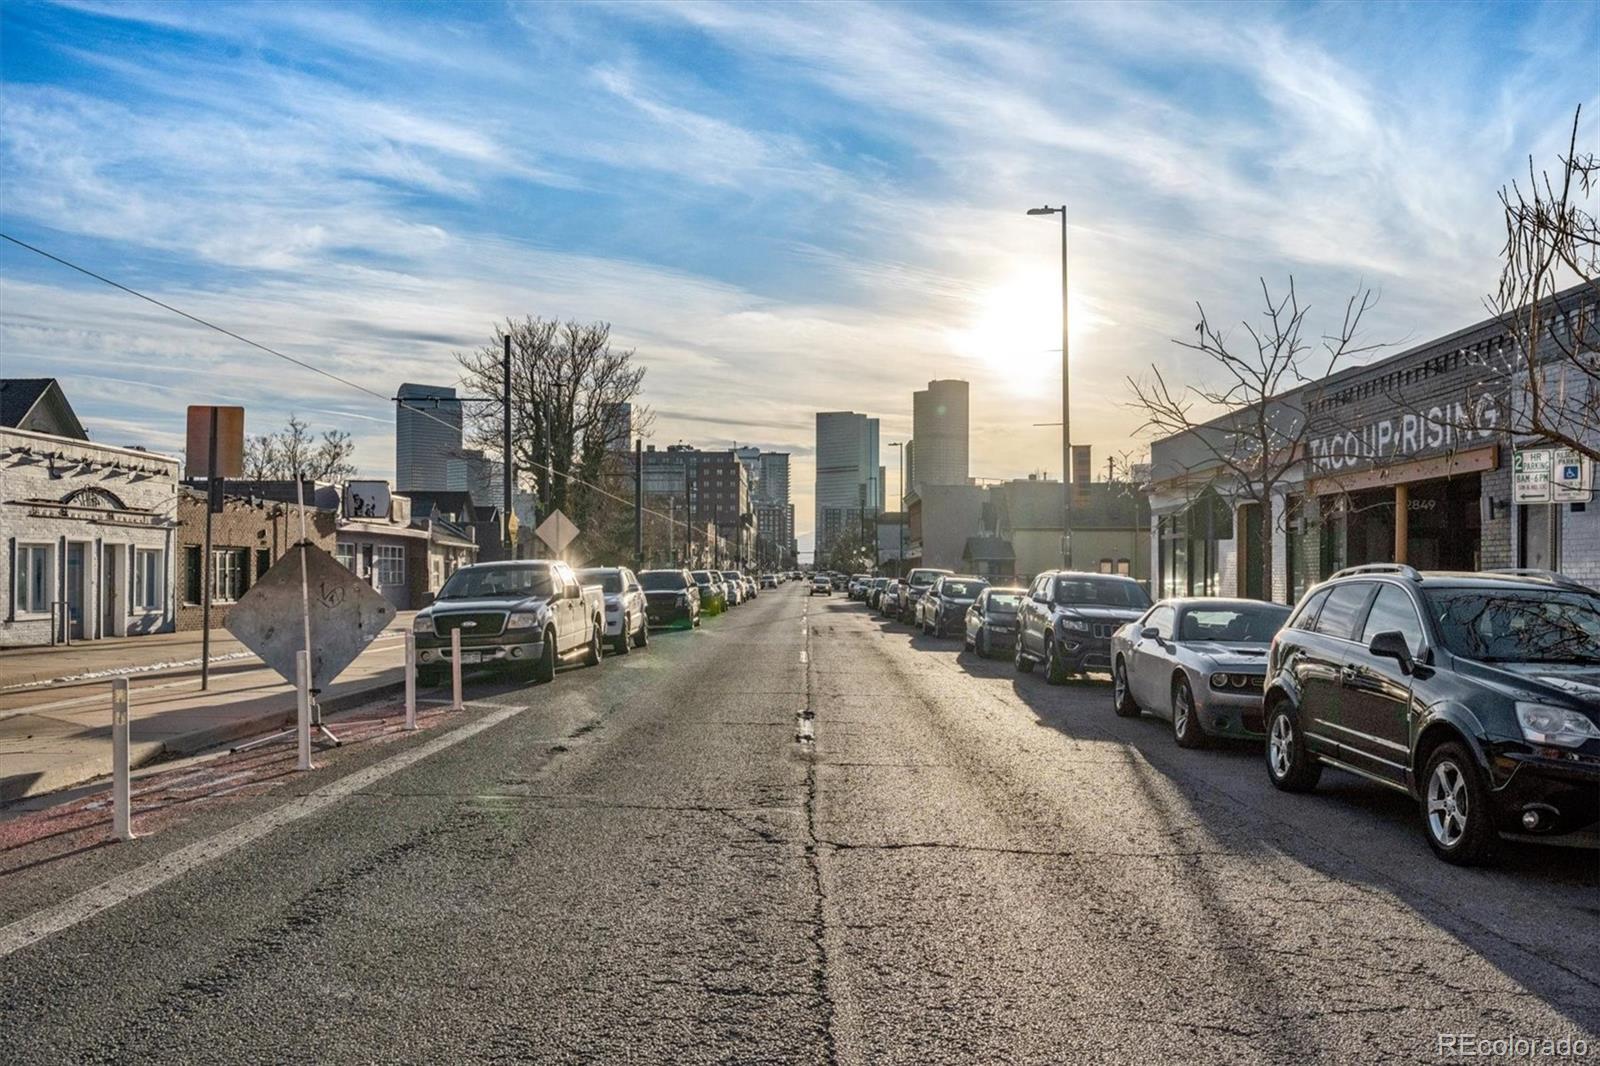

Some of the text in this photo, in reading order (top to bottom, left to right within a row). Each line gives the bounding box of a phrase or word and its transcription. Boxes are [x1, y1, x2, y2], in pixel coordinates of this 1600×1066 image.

[1310, 432, 1359, 472] TACO
[1515, 455, 1522, 470] 2
[1523, 462, 1549, 470] PARKING
